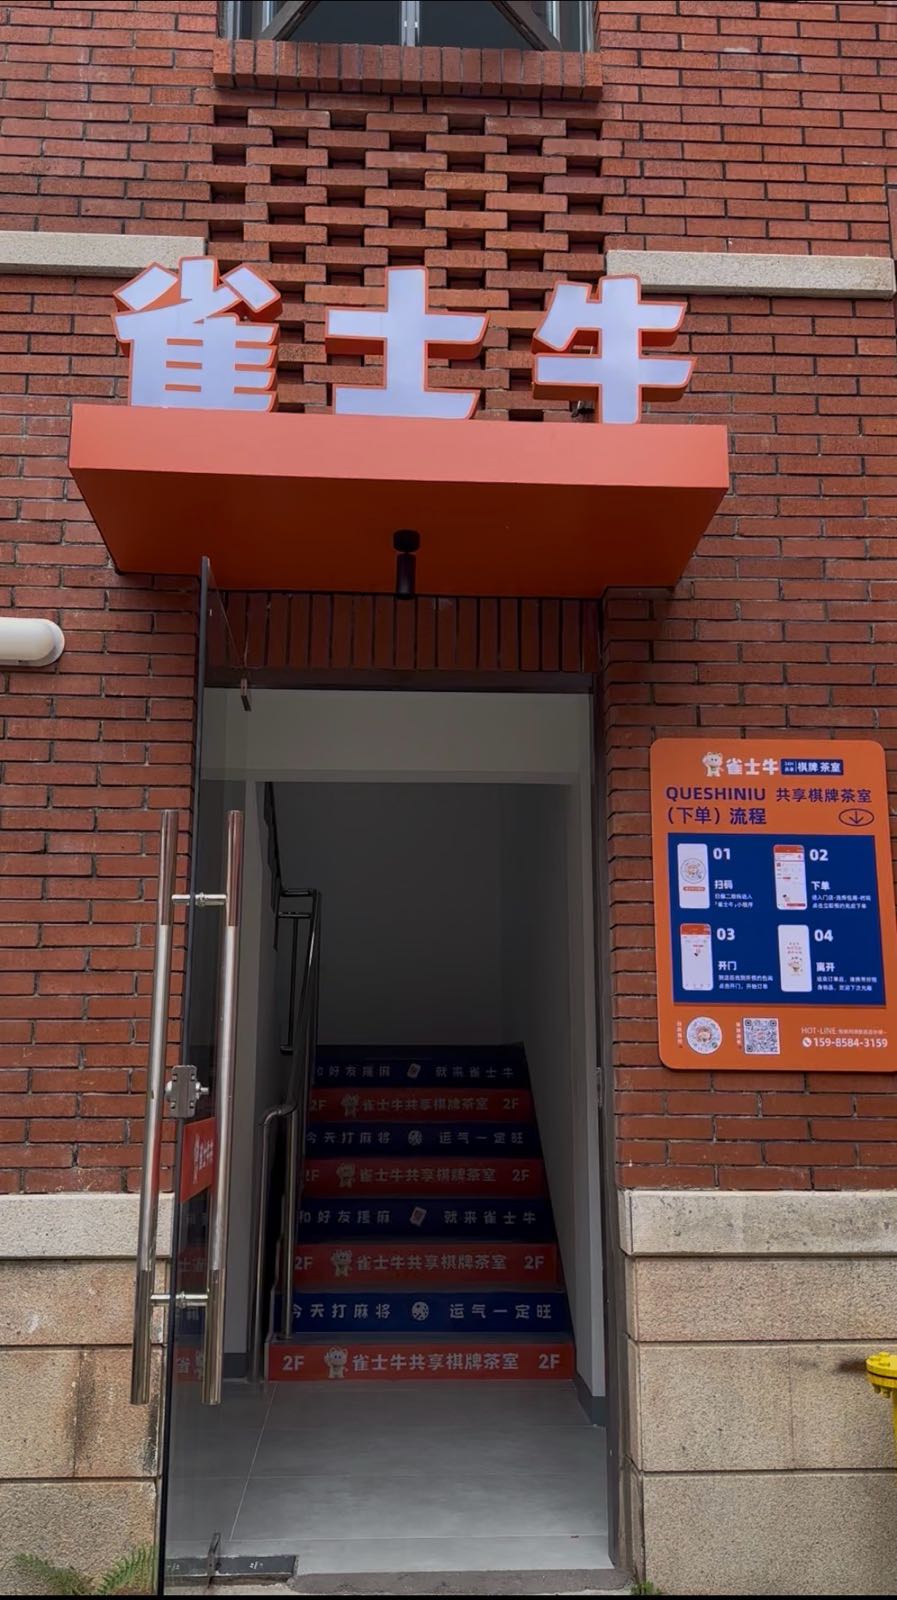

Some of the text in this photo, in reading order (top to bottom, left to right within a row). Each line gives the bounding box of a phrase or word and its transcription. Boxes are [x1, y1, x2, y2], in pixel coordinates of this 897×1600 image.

[112, 256, 695, 424] 雀士牛
[726, 757, 842, 776] 雀士牛 棋牌茶室
[666, 786, 873, 803] QUESHINIU 共享棋牌茶室
[713, 847, 731, 860] 01
[809, 848, 829, 861] 02
[714, 879, 733, 890] 扫码
[811, 880, 830, 891] 下单
[716, 927, 735, 941] 03
[814, 929, 834, 942] 04
[718, 960, 737, 971] 开门
[816, 961, 835, 973] 离开
[801, 1026, 836, 1036] HOT-LINE
[813, 1037, 888, 1049] 159-8584-3159
[362, 1097, 489, 1112] 雀士牛共享棋牌茶室
[503, 1097, 520, 1111] 2F
[306, 1131, 524, 1145] 今天打麻将 运气一定旺
[359, 1167, 497, 1183] 雀士牛共享棋牌茶室
[512, 1168, 530, 1183] 2F
[444, 1209, 537, 1226] 就来雀士牛
[295, 1254, 545, 1272] 2F 雀士牛共享棋牌茶室 2F
[292, 1303, 552, 1320] 今天打麻将 运气一定旺
[282, 1353, 561, 1372] 2F 雀士牛共享棋牌茶室 2F
